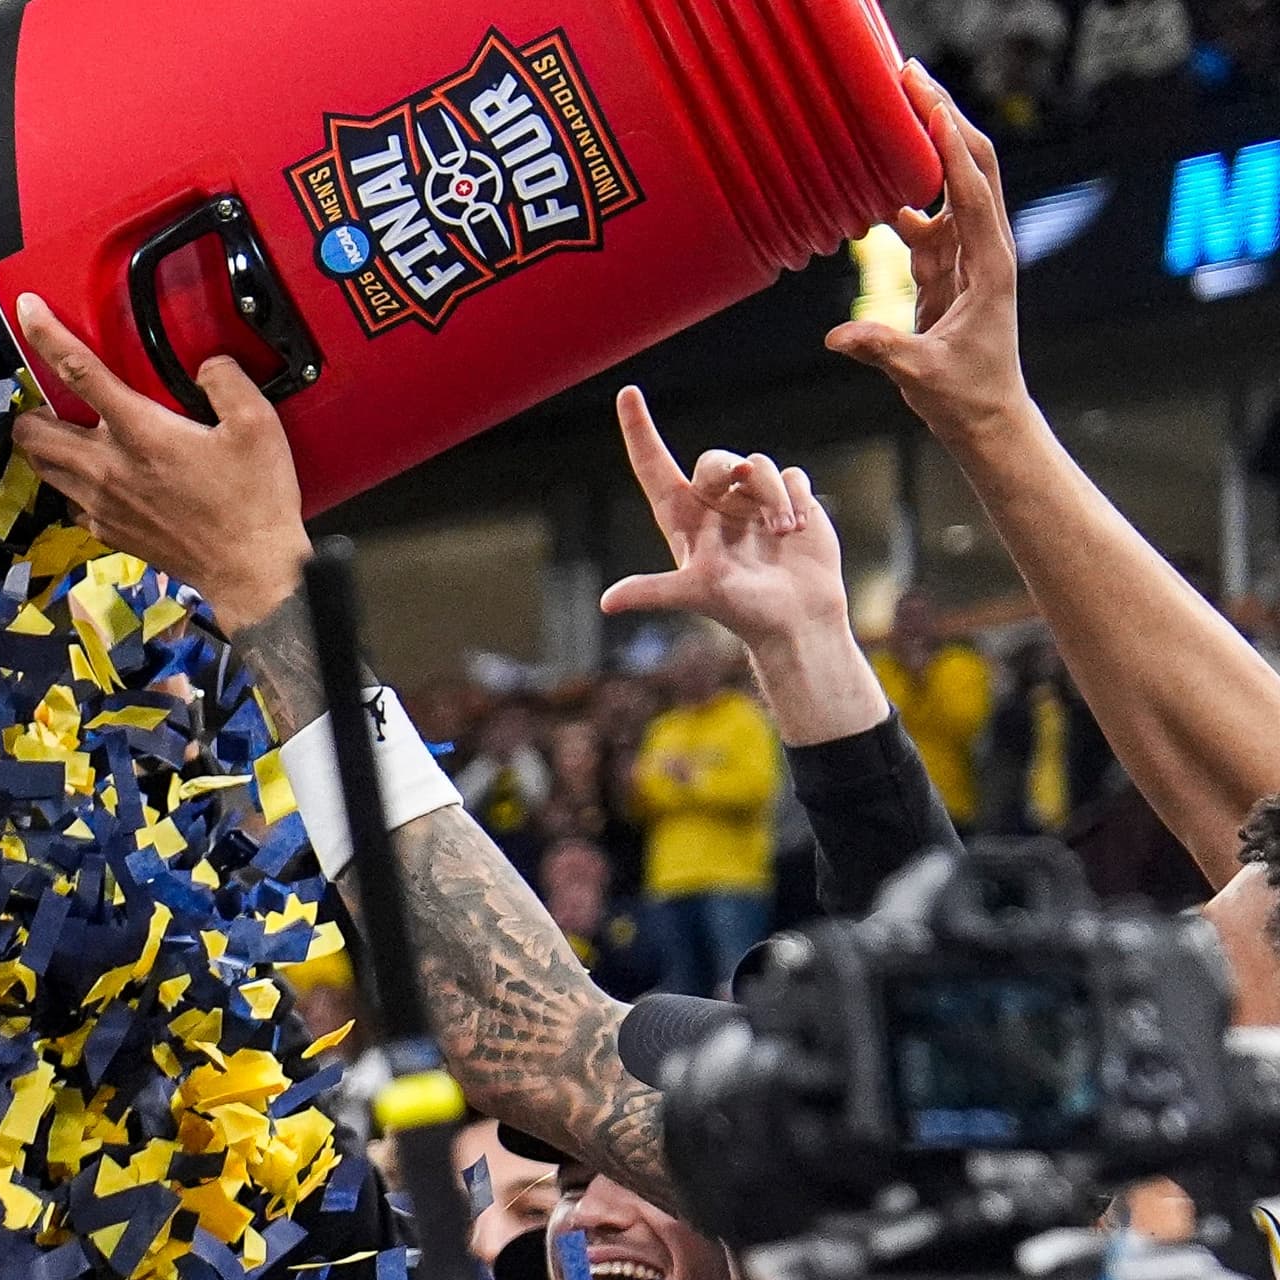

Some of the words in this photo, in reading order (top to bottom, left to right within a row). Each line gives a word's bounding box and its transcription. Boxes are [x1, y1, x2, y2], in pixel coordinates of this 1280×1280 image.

[469, 72, 580, 232] FOUR
[531, 53, 622, 202] INDIANAPOLIS
[307, 165, 343, 223] MEN'S
[335, 225, 365, 265] NCAA
[349, 134, 467, 301] FINAL
[356, 270, 400, 317] 2026
